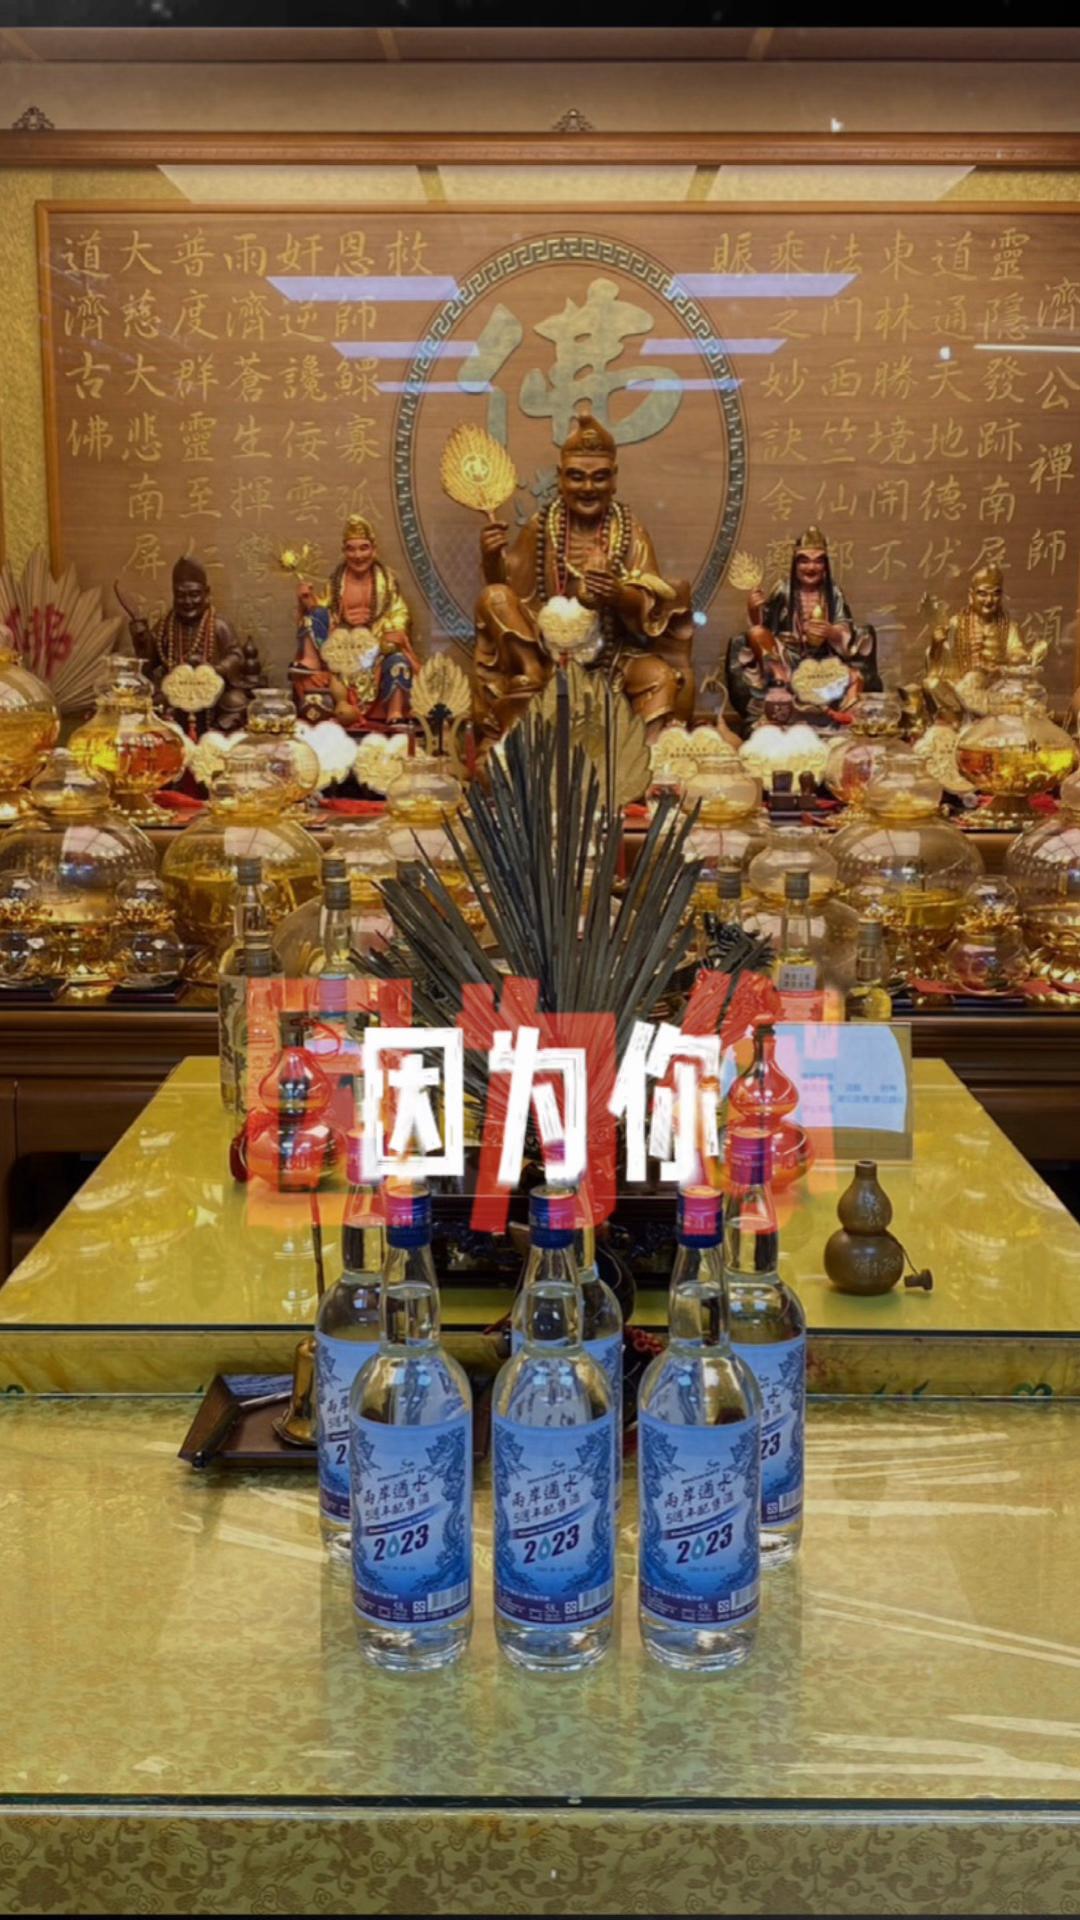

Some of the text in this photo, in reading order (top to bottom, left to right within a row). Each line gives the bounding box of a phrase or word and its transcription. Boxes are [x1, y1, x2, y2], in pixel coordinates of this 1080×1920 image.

[385, 230, 433, 277] 救
[62, 230, 114, 462] 道濟古佛
[457, 277, 685, 451] 佛
[373, 1523, 430, 1562] 2023
[523, 1524, 580, 1564] 2023
[676, 1523, 734, 1564] 2023
